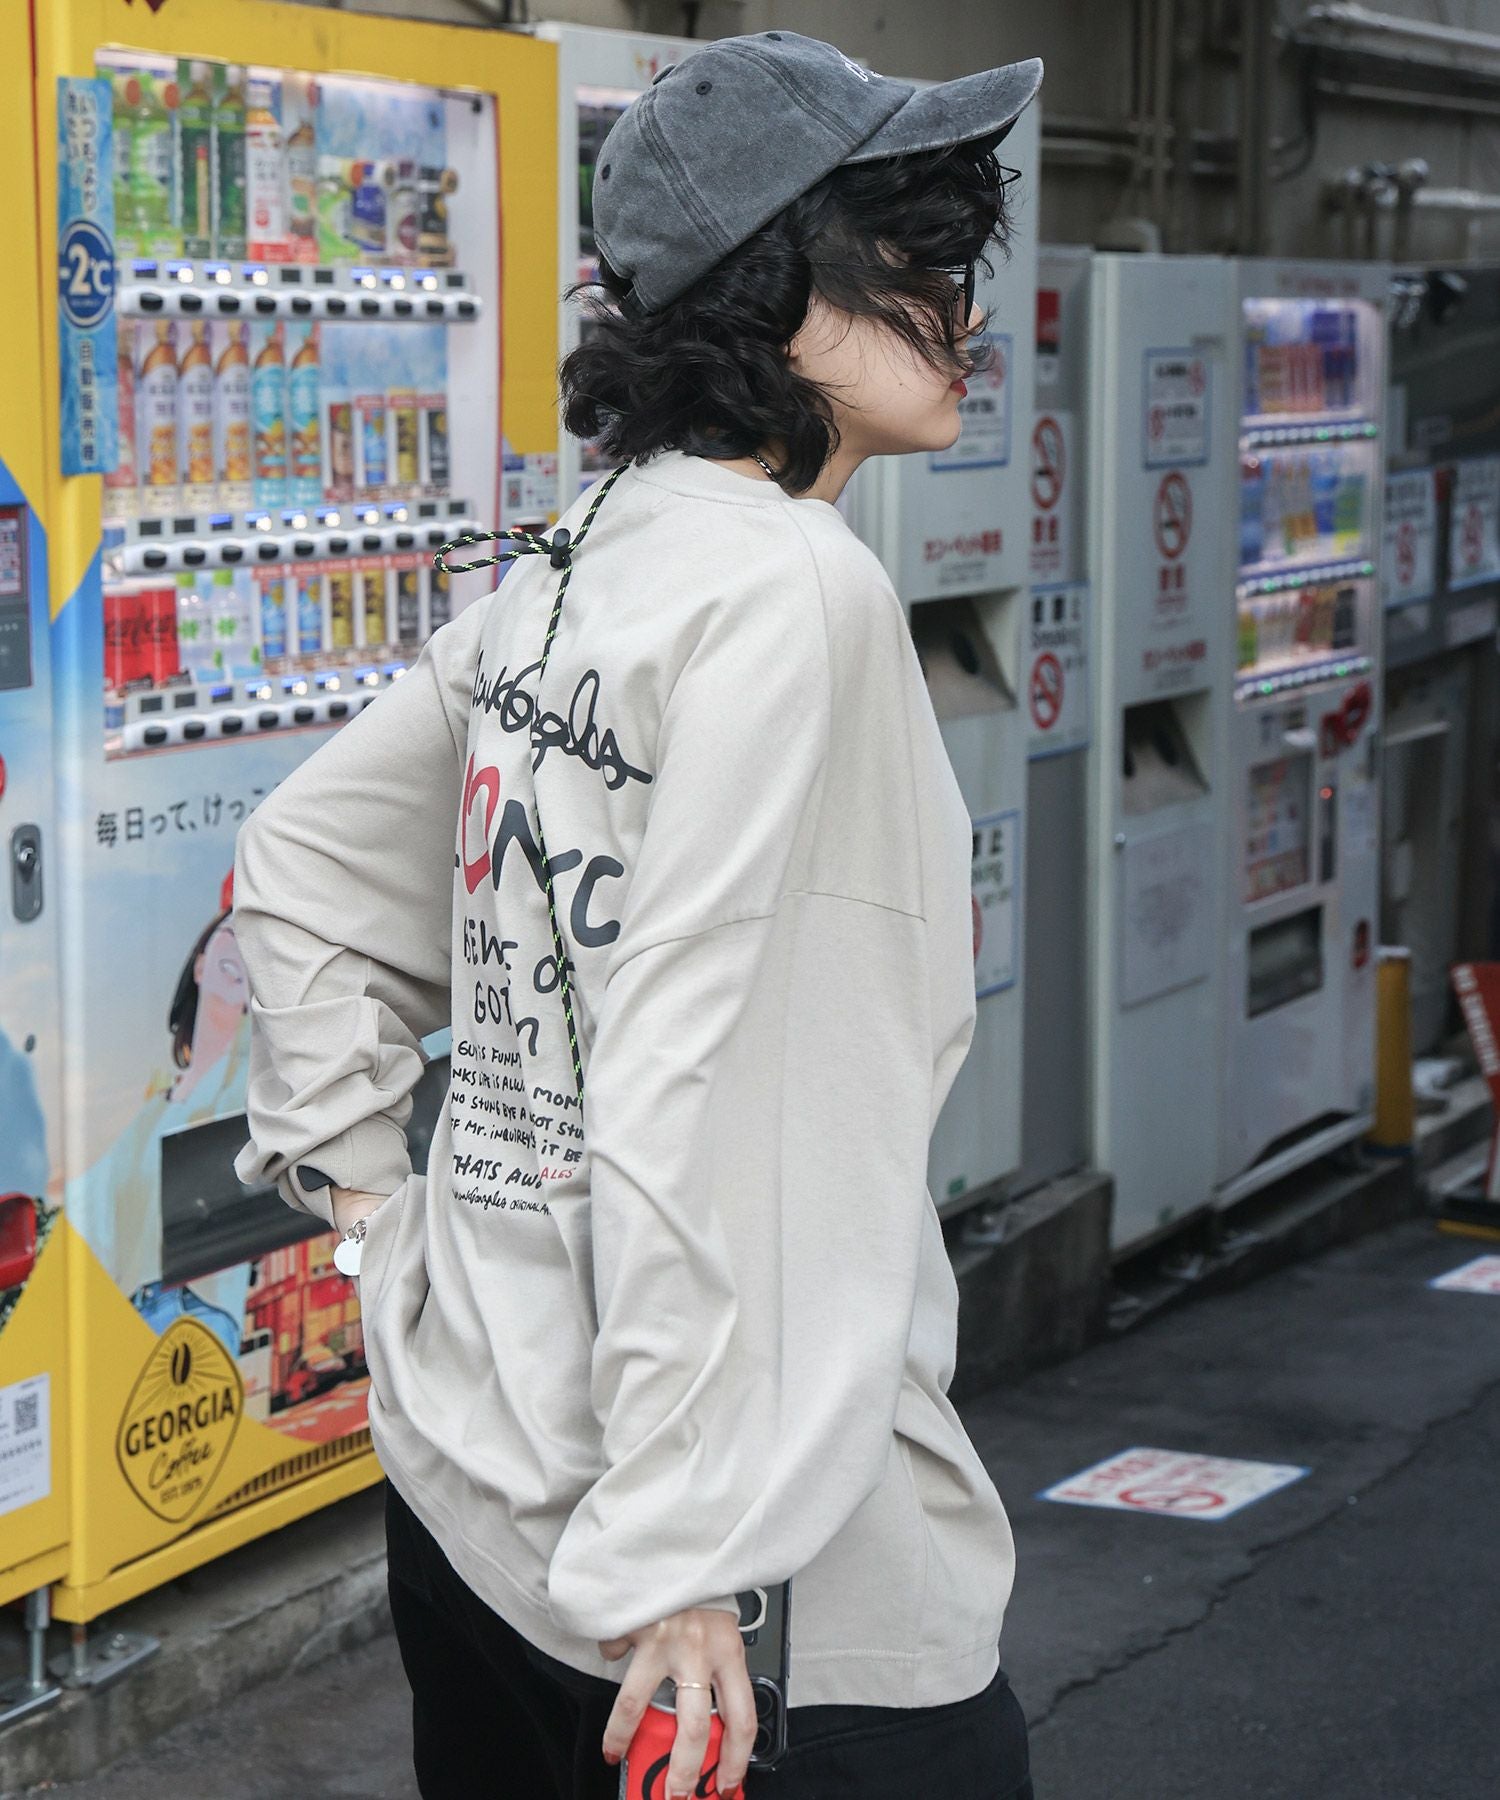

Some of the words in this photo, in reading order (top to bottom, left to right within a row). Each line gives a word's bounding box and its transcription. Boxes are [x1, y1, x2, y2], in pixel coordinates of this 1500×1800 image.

[452, 1068, 477, 1086] NKS
[502, 1075, 525, 1092] ALW
[533, 1087, 581, 1110] MON
[125, 1387, 235, 1457] GEORGIA
[148, 1437, 212, 1490] Coffee
